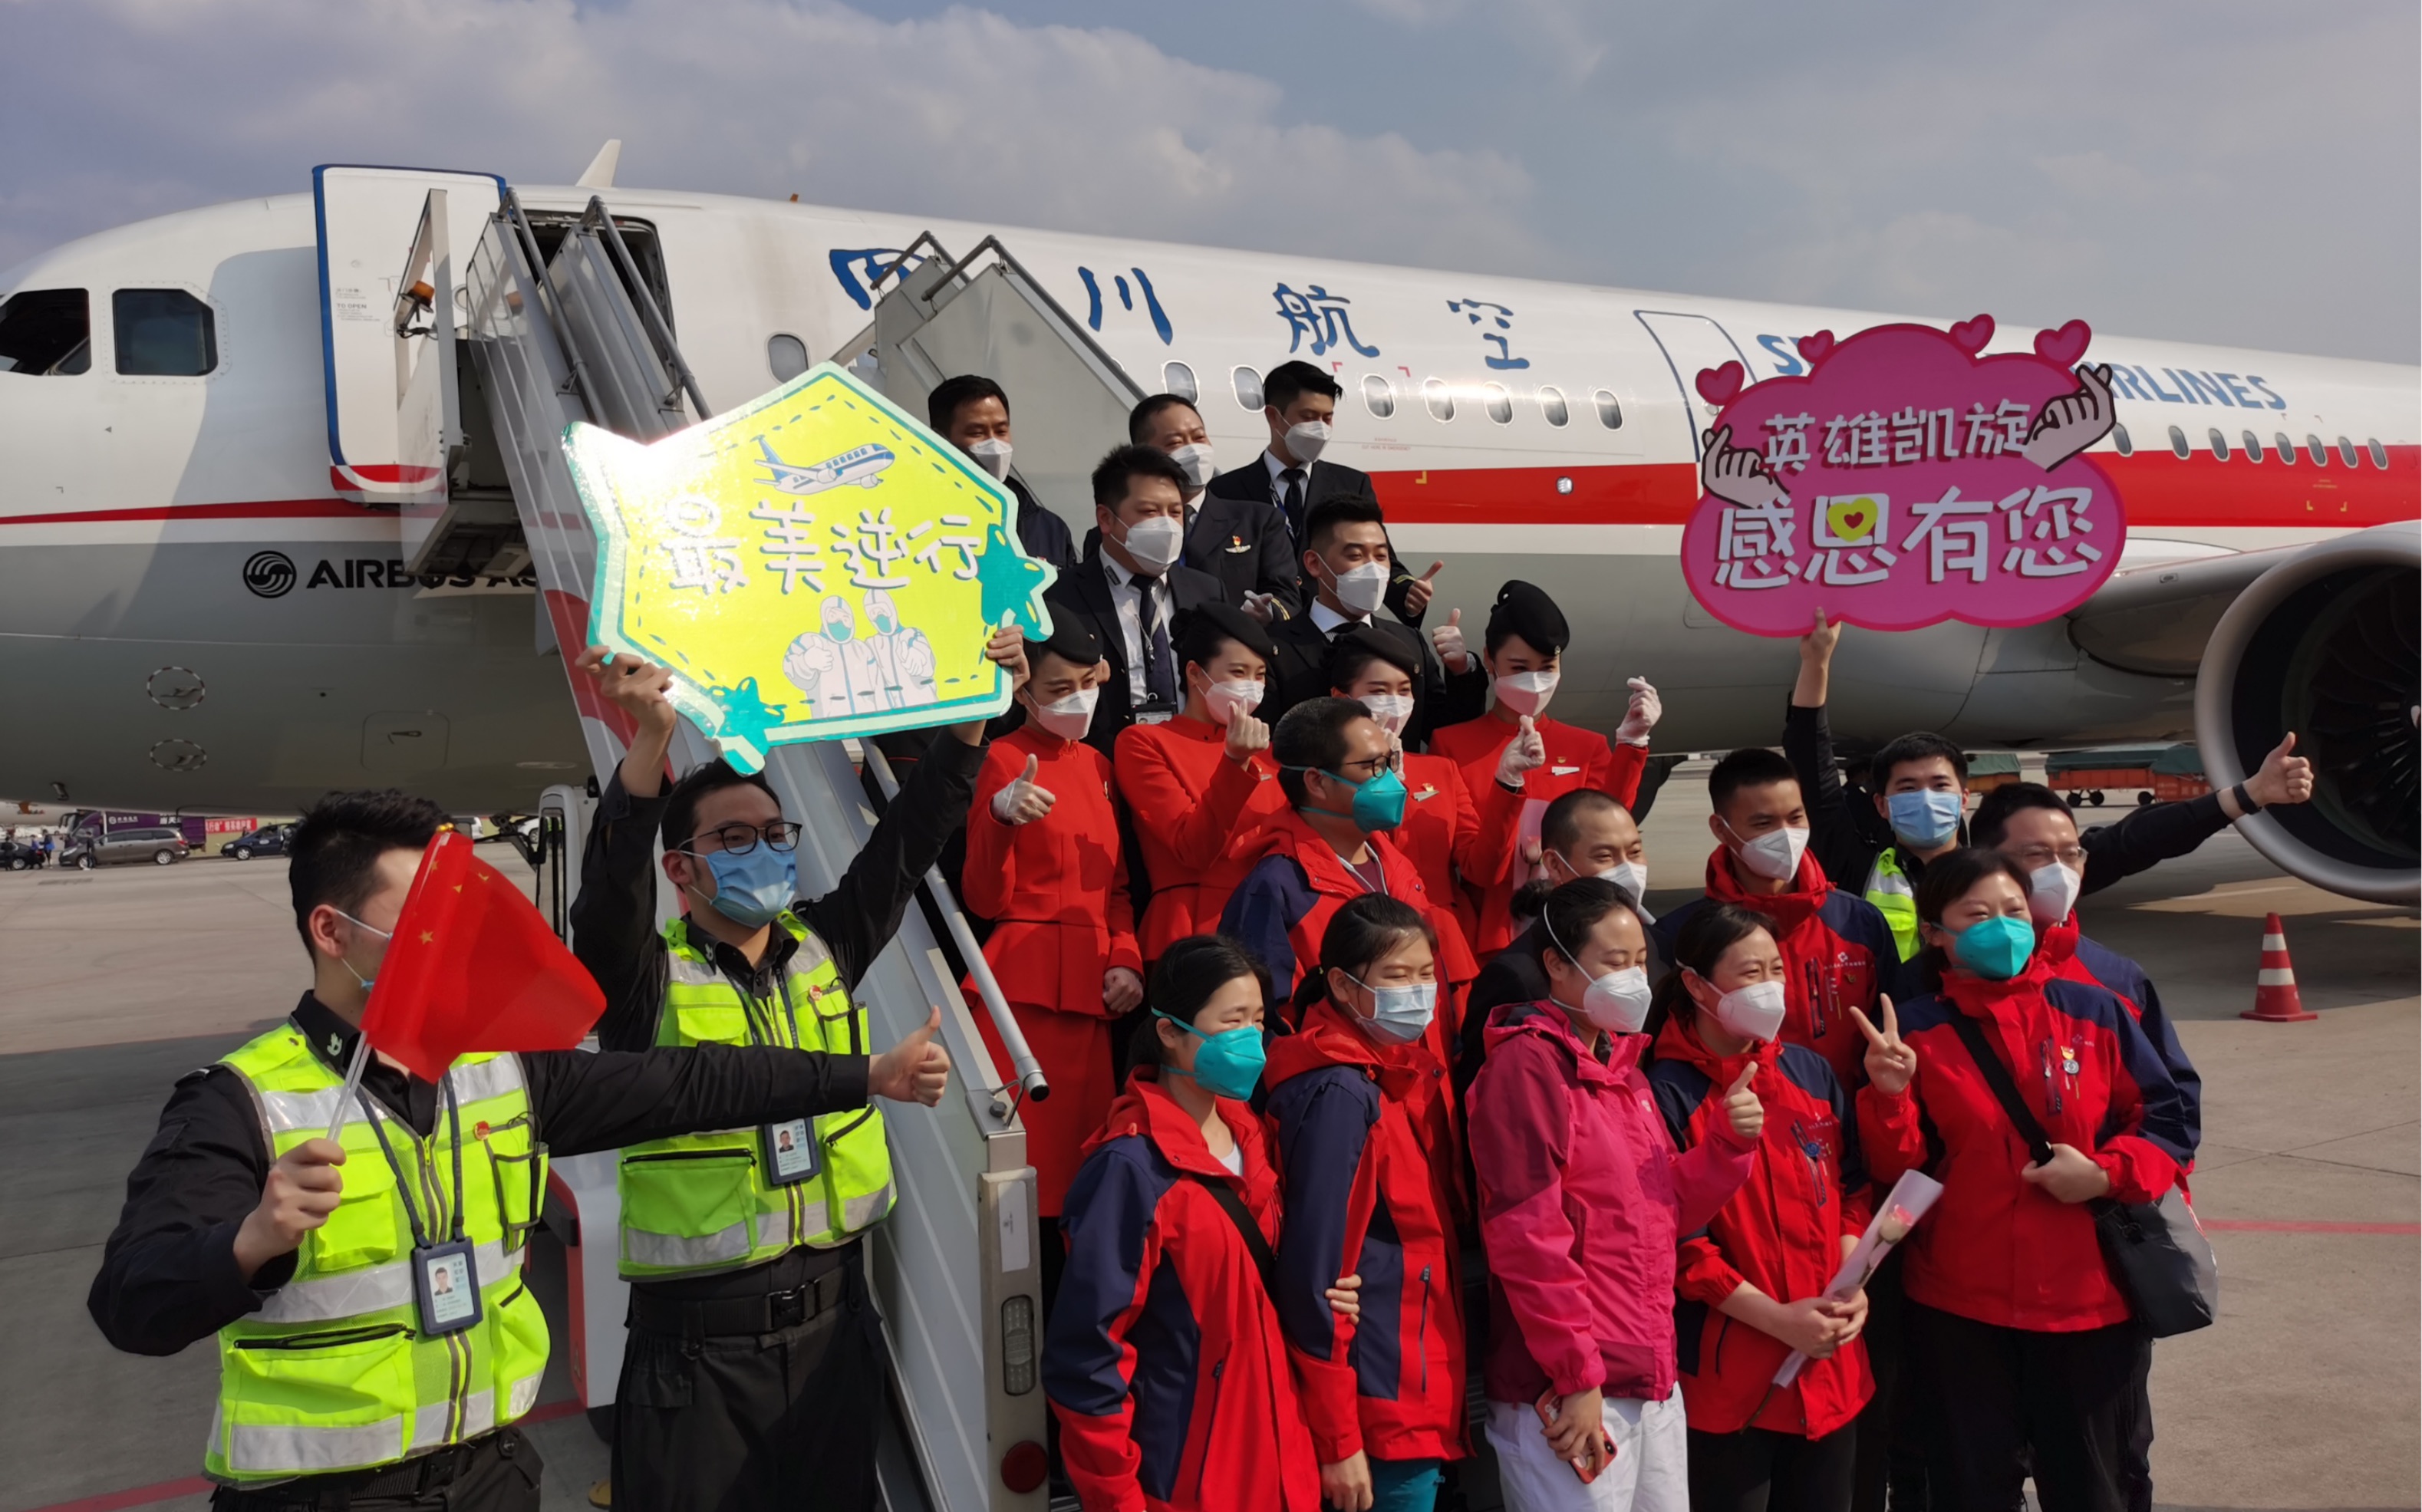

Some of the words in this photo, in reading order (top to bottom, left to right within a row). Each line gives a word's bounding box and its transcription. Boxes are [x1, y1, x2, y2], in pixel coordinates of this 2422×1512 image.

[1765, 399, 2031, 473] 英雄凯旋
[659, 499, 984, 596] 最美逆行
[1715, 485, 2103, 589] 感恩有您
